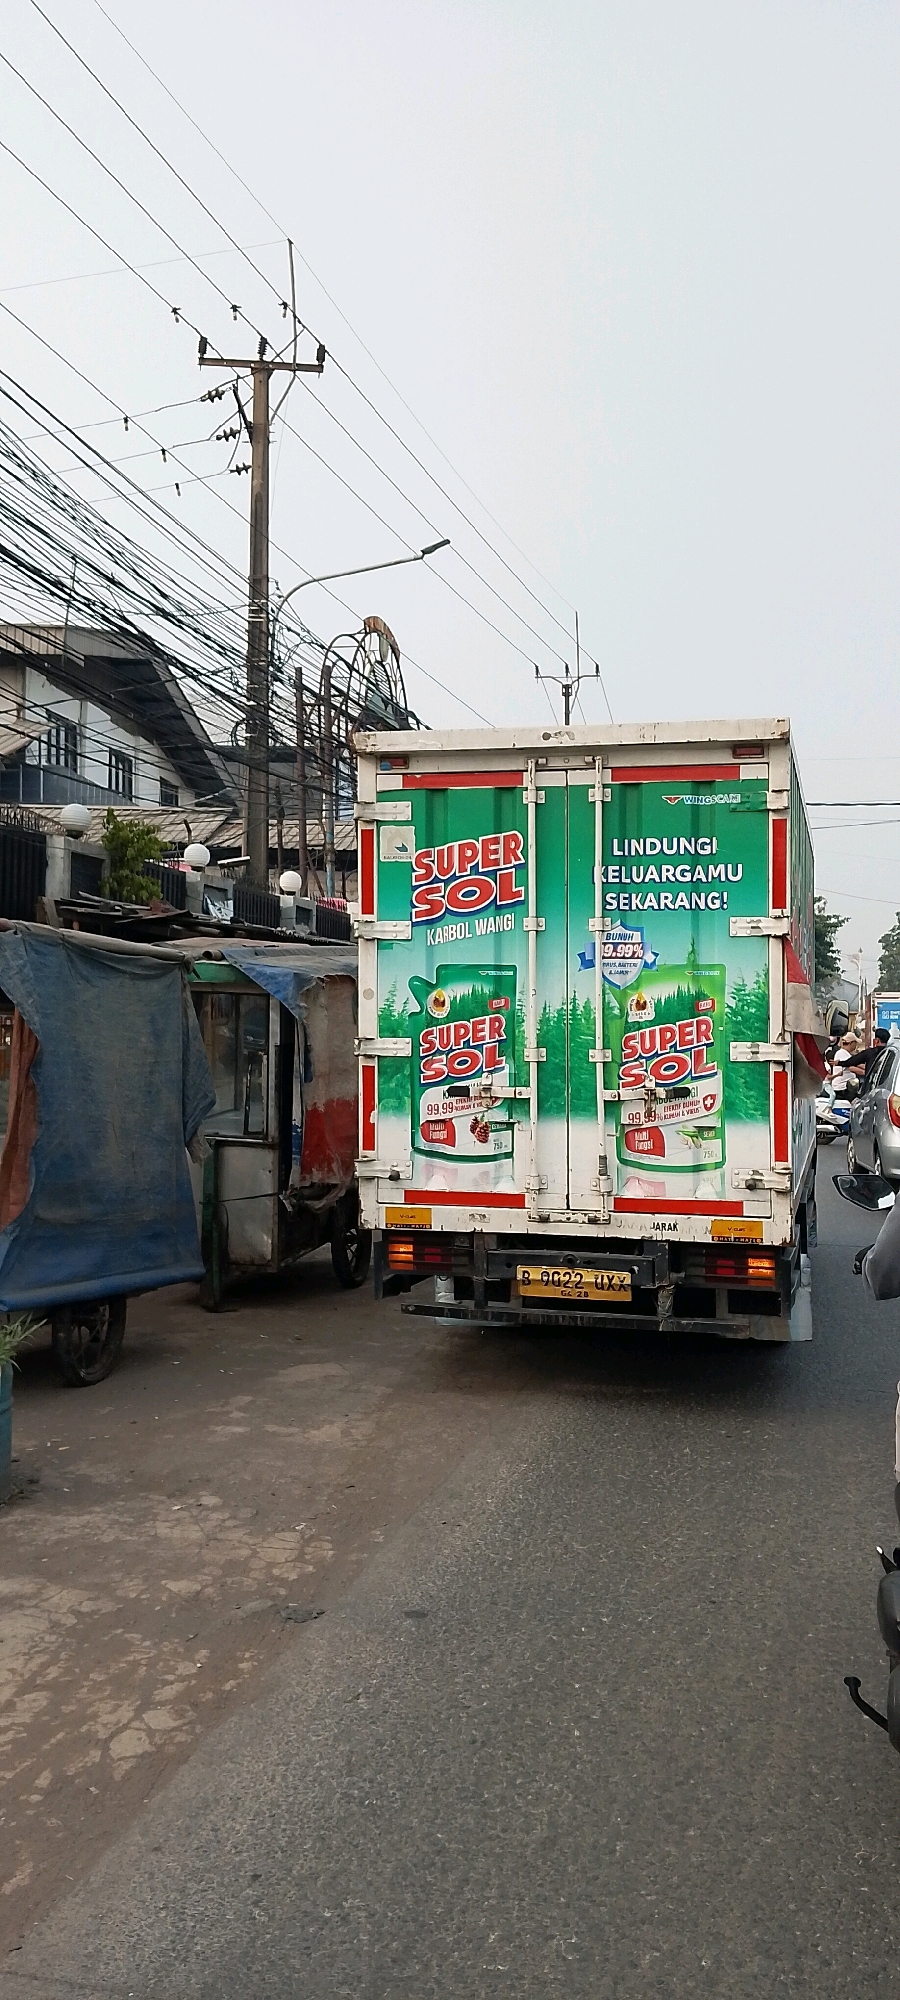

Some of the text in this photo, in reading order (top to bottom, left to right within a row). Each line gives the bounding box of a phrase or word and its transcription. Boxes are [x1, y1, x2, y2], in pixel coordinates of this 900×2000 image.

[612, 836, 718, 857] LINDUNGI
[411, 830, 526, 887] SUPER
[411, 867, 525, 923] SOL
[604, 890, 729, 911] SEKARANG!
[426, 912, 515, 947] KARBOL WANGI
[605, 932, 635, 942] BUNUH
[601, 943, 644, 958] 9.99%
[419, 1013, 507, 1057] SUPER
[621, 1015, 714, 1061] SUPER
[420, 1042, 506, 1084] SOL
[619, 1045, 718, 1090] SOL
[635, 1138, 654, 1150] Fungsi
[703, 1150, 714, 1159] 750
[650, 1221, 679, 1232] JARAK
[521, 1269, 532, 1287] B
